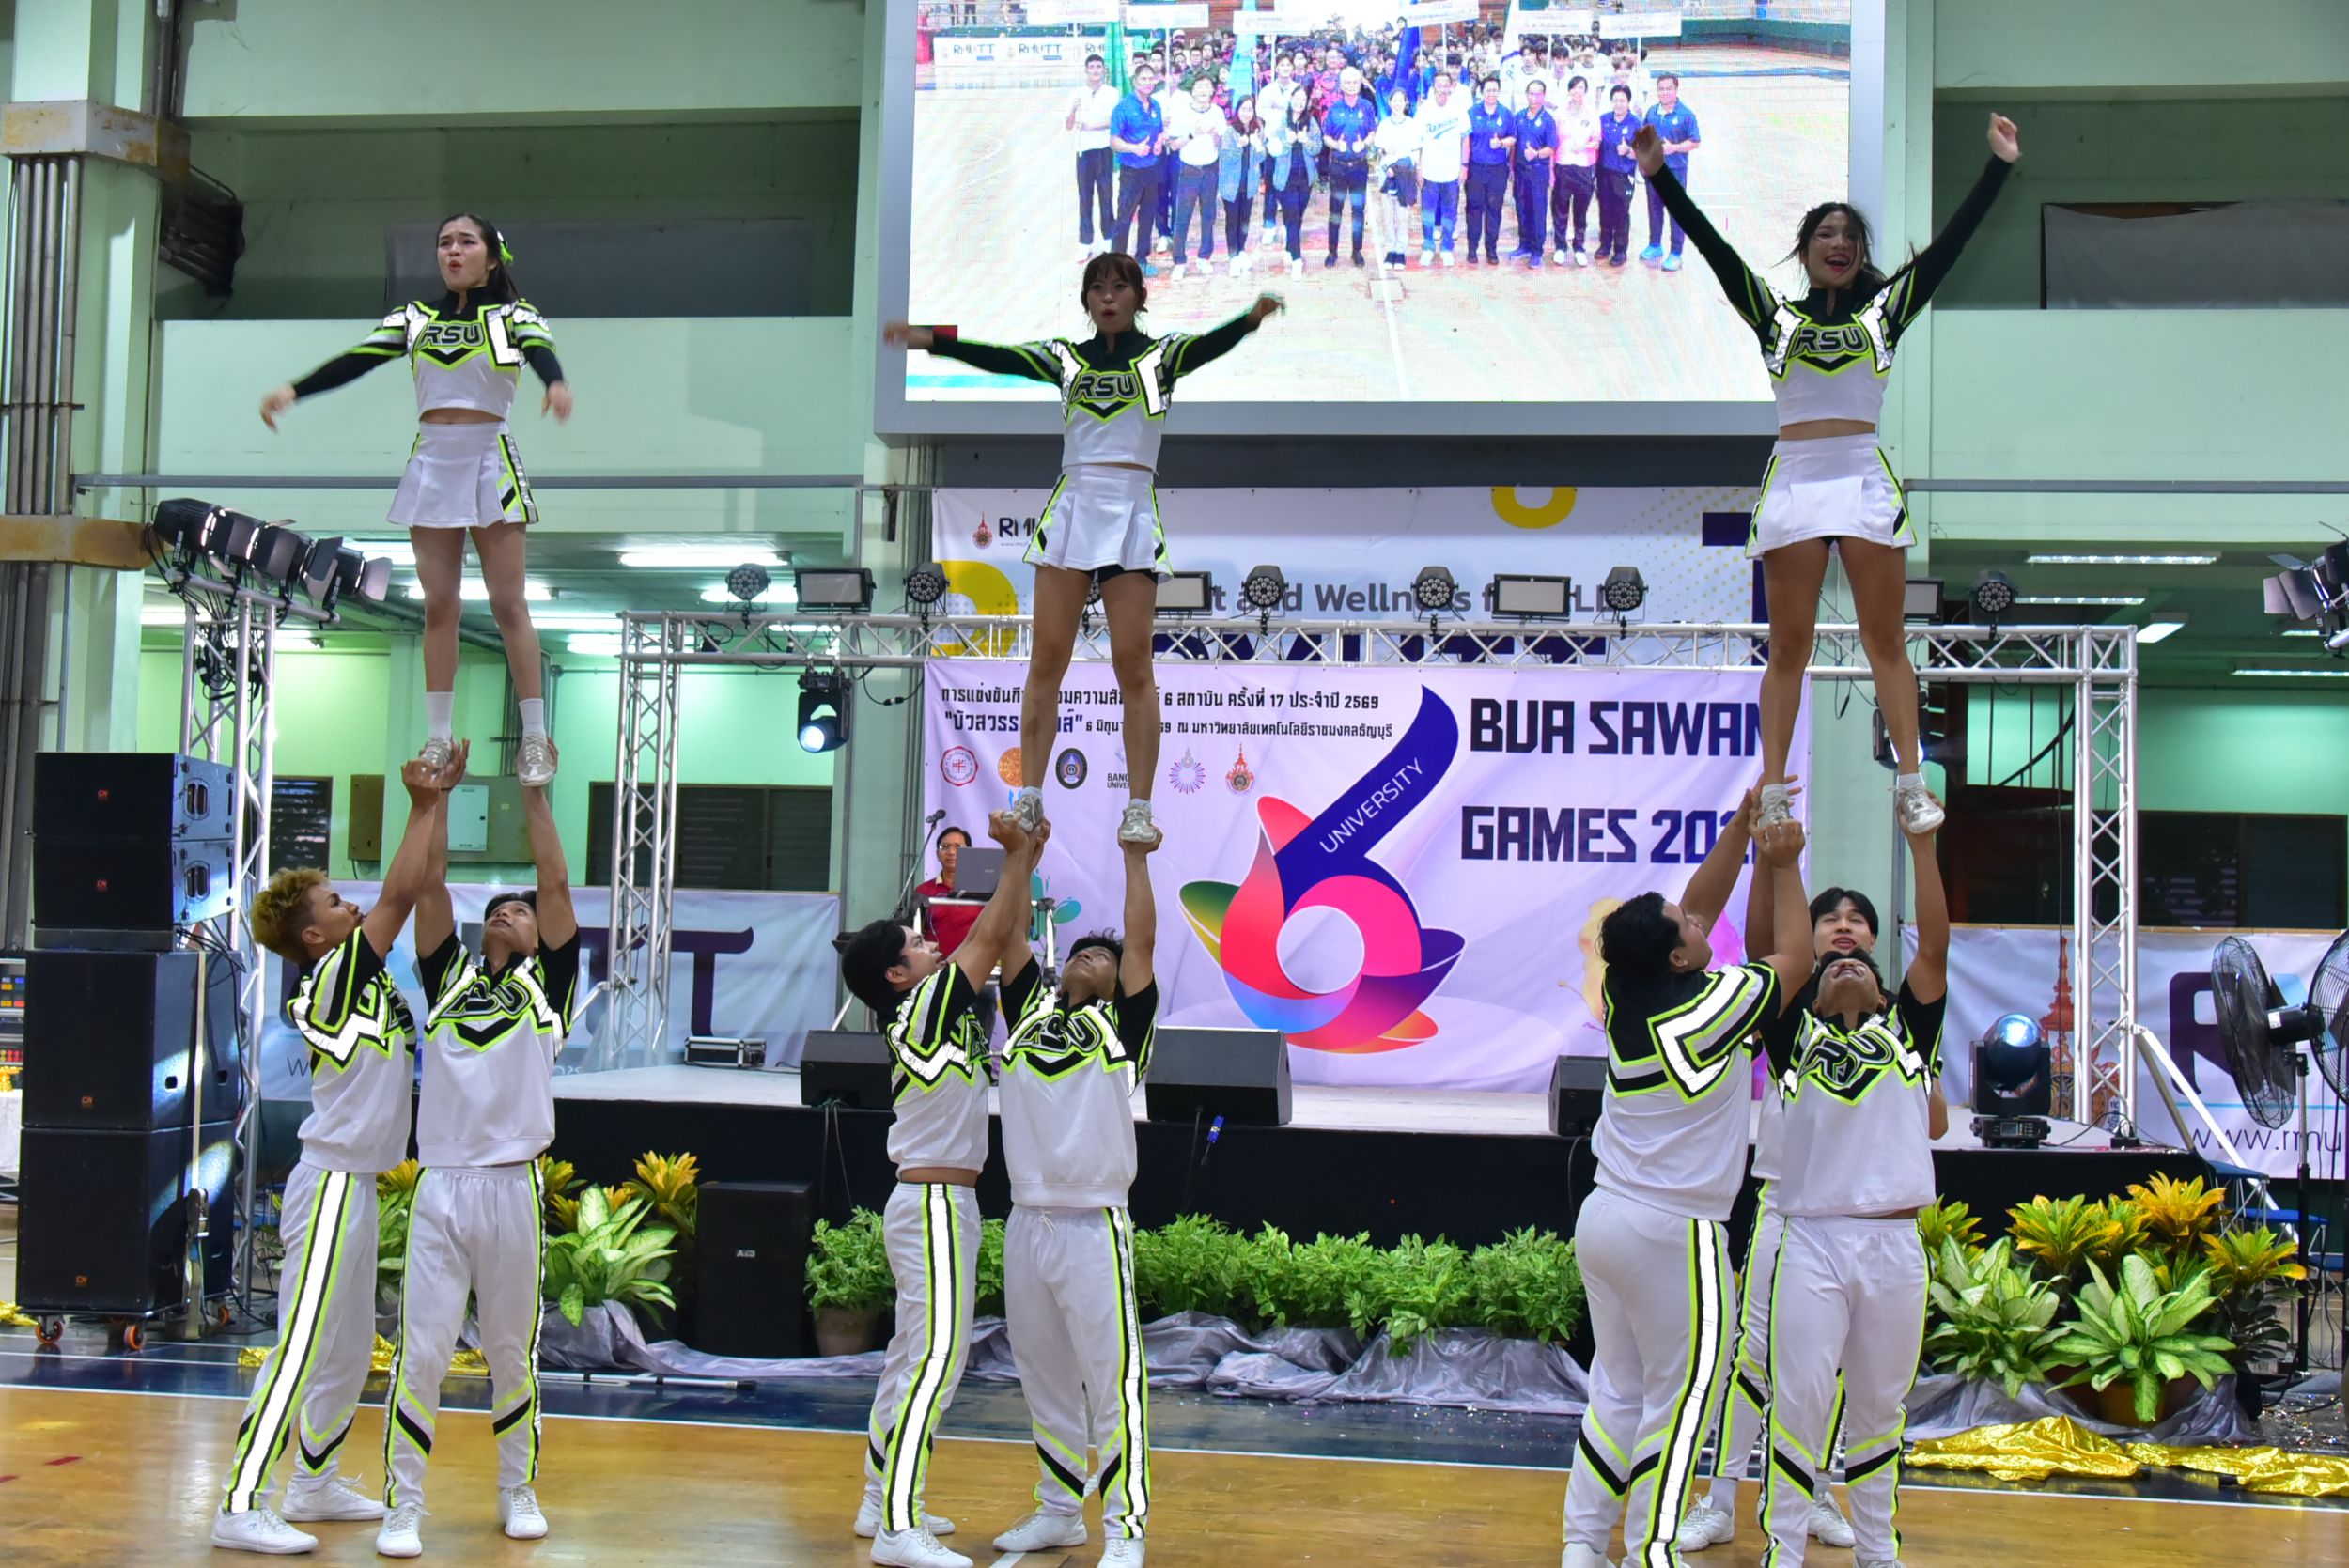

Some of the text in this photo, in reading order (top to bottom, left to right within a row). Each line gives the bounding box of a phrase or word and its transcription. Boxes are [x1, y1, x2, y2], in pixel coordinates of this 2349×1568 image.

[419, 322, 485, 347] RSU
[1793, 327, 1869, 353] RSU
[1073, 373, 1140, 399] RSU
[1315, 582, 1472, 613] Wellns
[1164, 692, 1173, 706] 6
[1177, 690, 1223, 706] สถาบัน
[1228, 687, 1266, 707] ครั้งที่
[1270, 694, 1284, 707] 17
[1289, 691, 1340, 709] ประจำปี
[1344, 695, 1379, 709] 2569
[1086, 721, 1093, 732] 6
[1470, 698, 1574, 753] BUA
[1319, 757, 1423, 853] UNIVERSITY
[1461, 805, 1755, 864] GAMES 20
